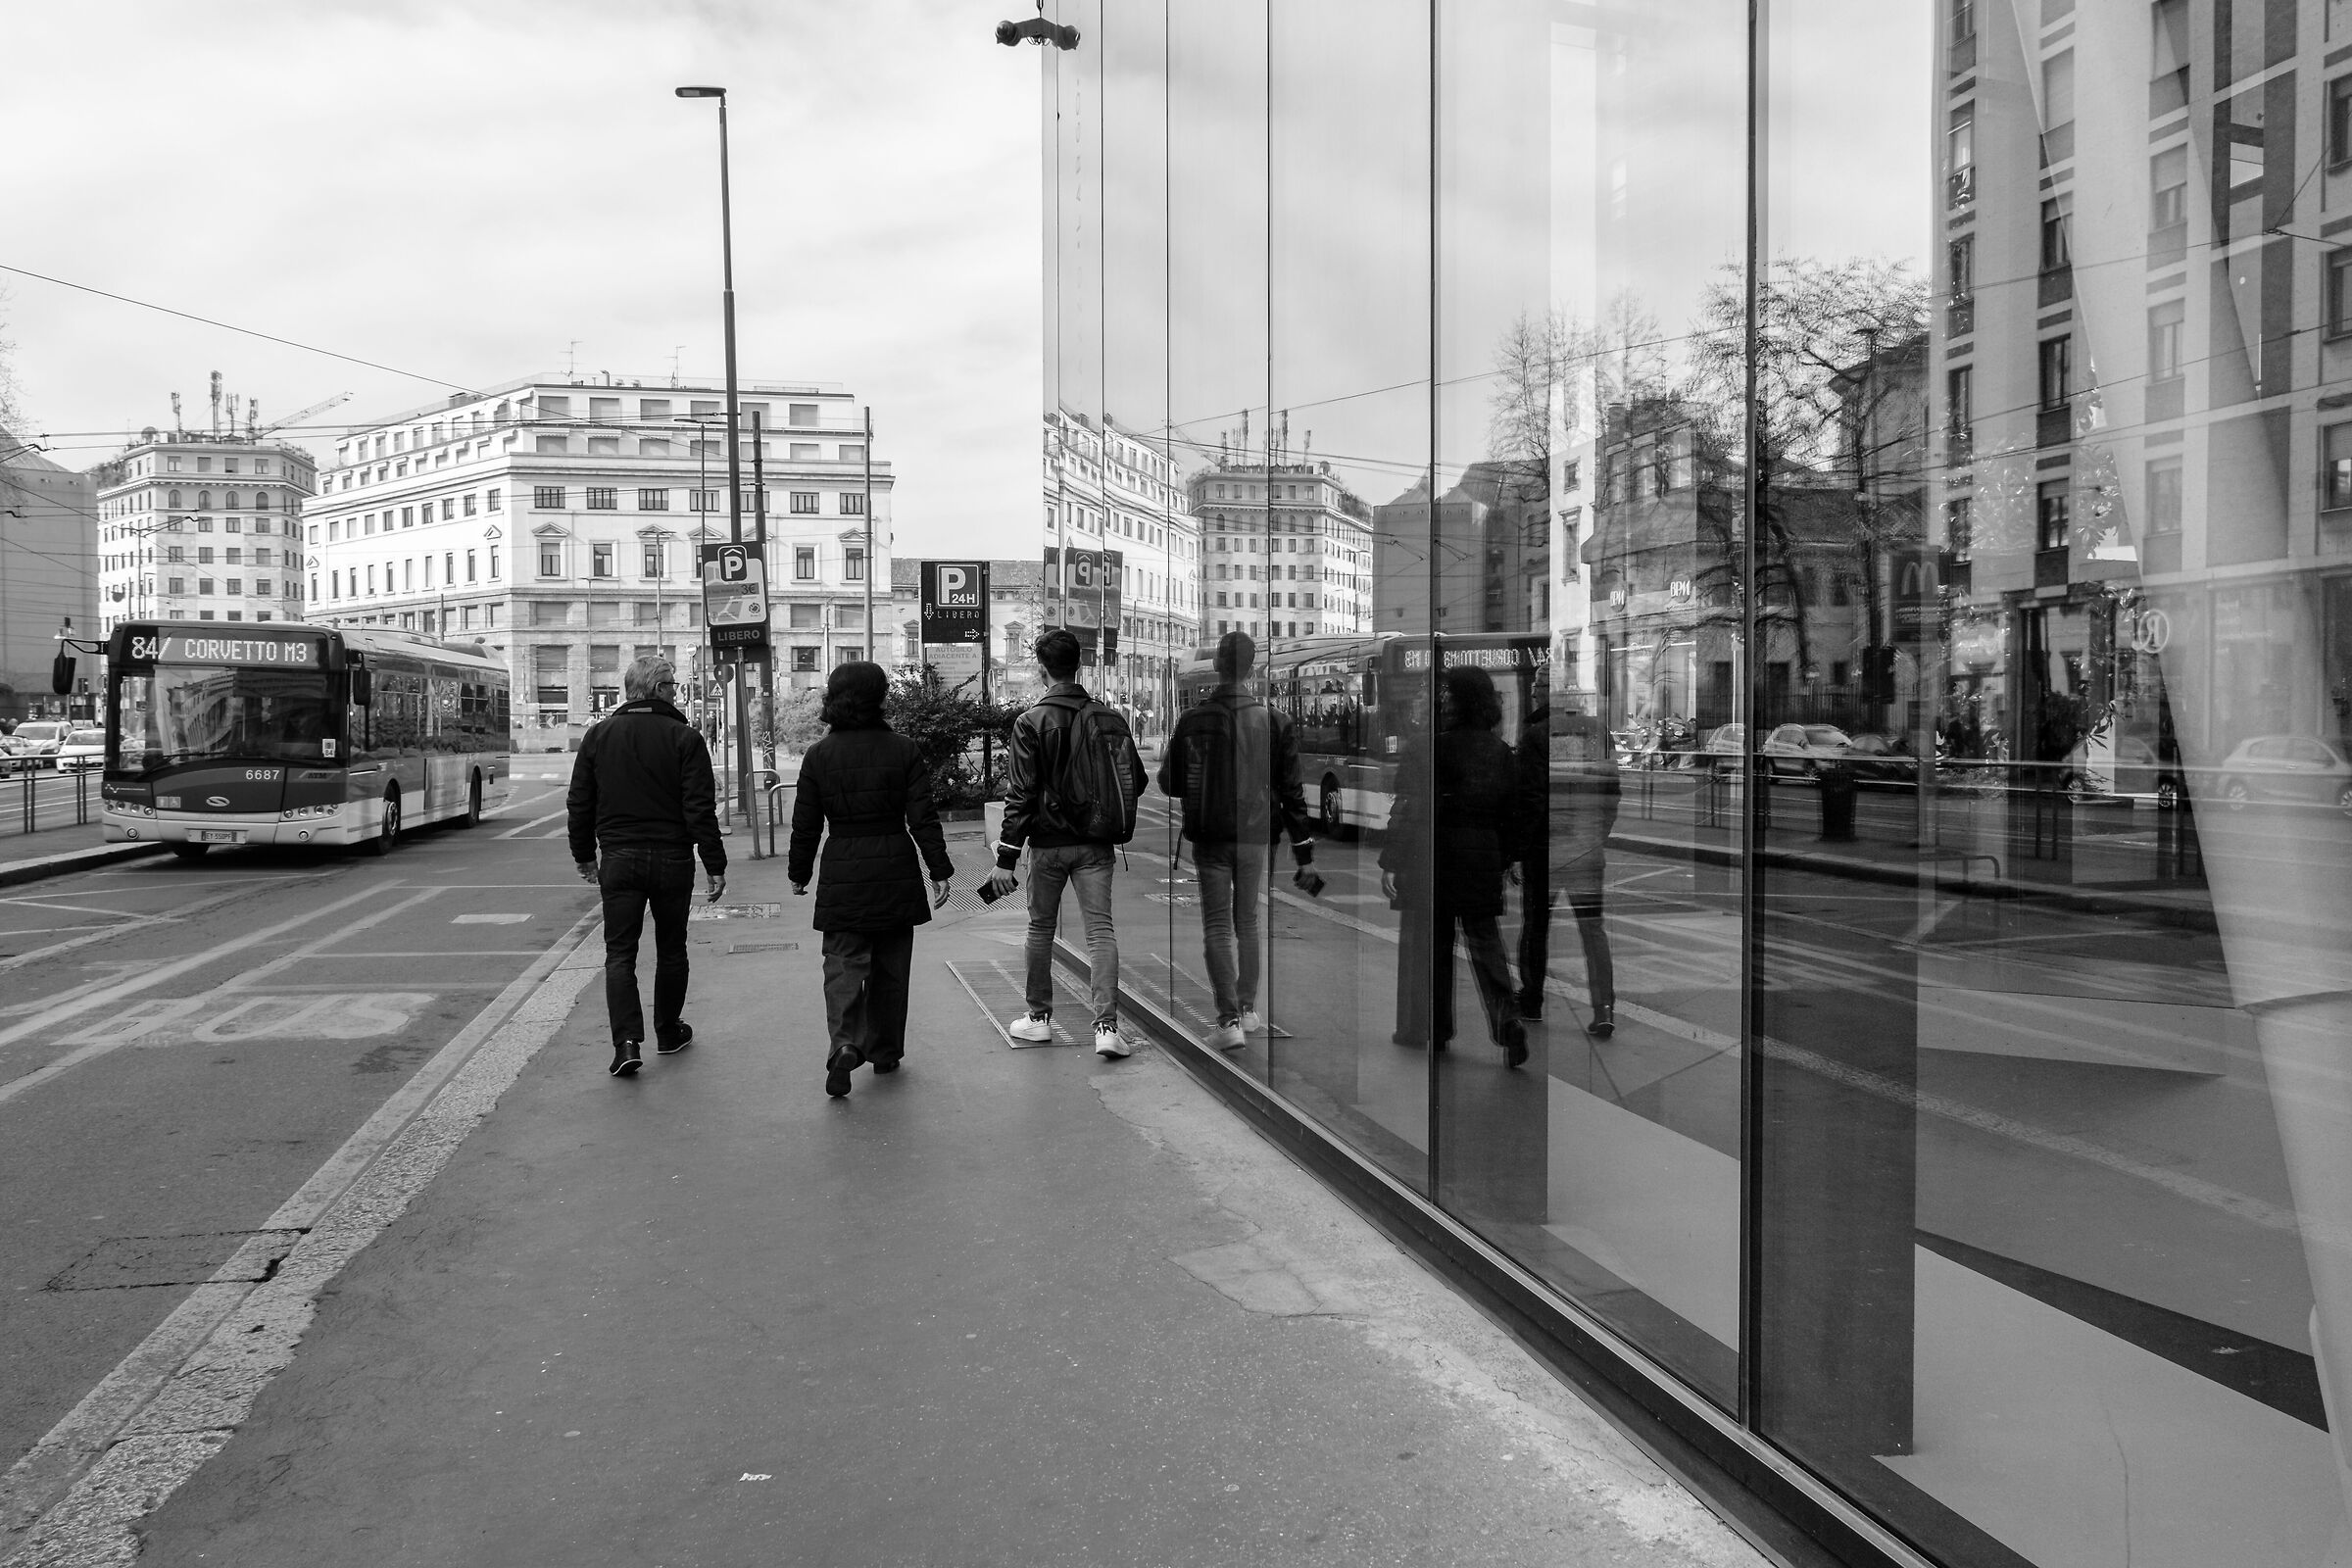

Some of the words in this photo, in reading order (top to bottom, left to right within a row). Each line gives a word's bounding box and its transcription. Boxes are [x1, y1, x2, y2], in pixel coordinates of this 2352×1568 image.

[724, 556, 743, 579] P
[740, 583, 756, 595] 3€
[941, 567, 966, 604] P
[937, 611, 980, 619] LIBERO
[717, 629, 760, 642] LIBERO
[184, 638, 277, 662] CORVETTO
[284, 642, 307, 662] M3
[245, 769, 280, 781] 6687
[51, 992, 437, 1047] BUS
